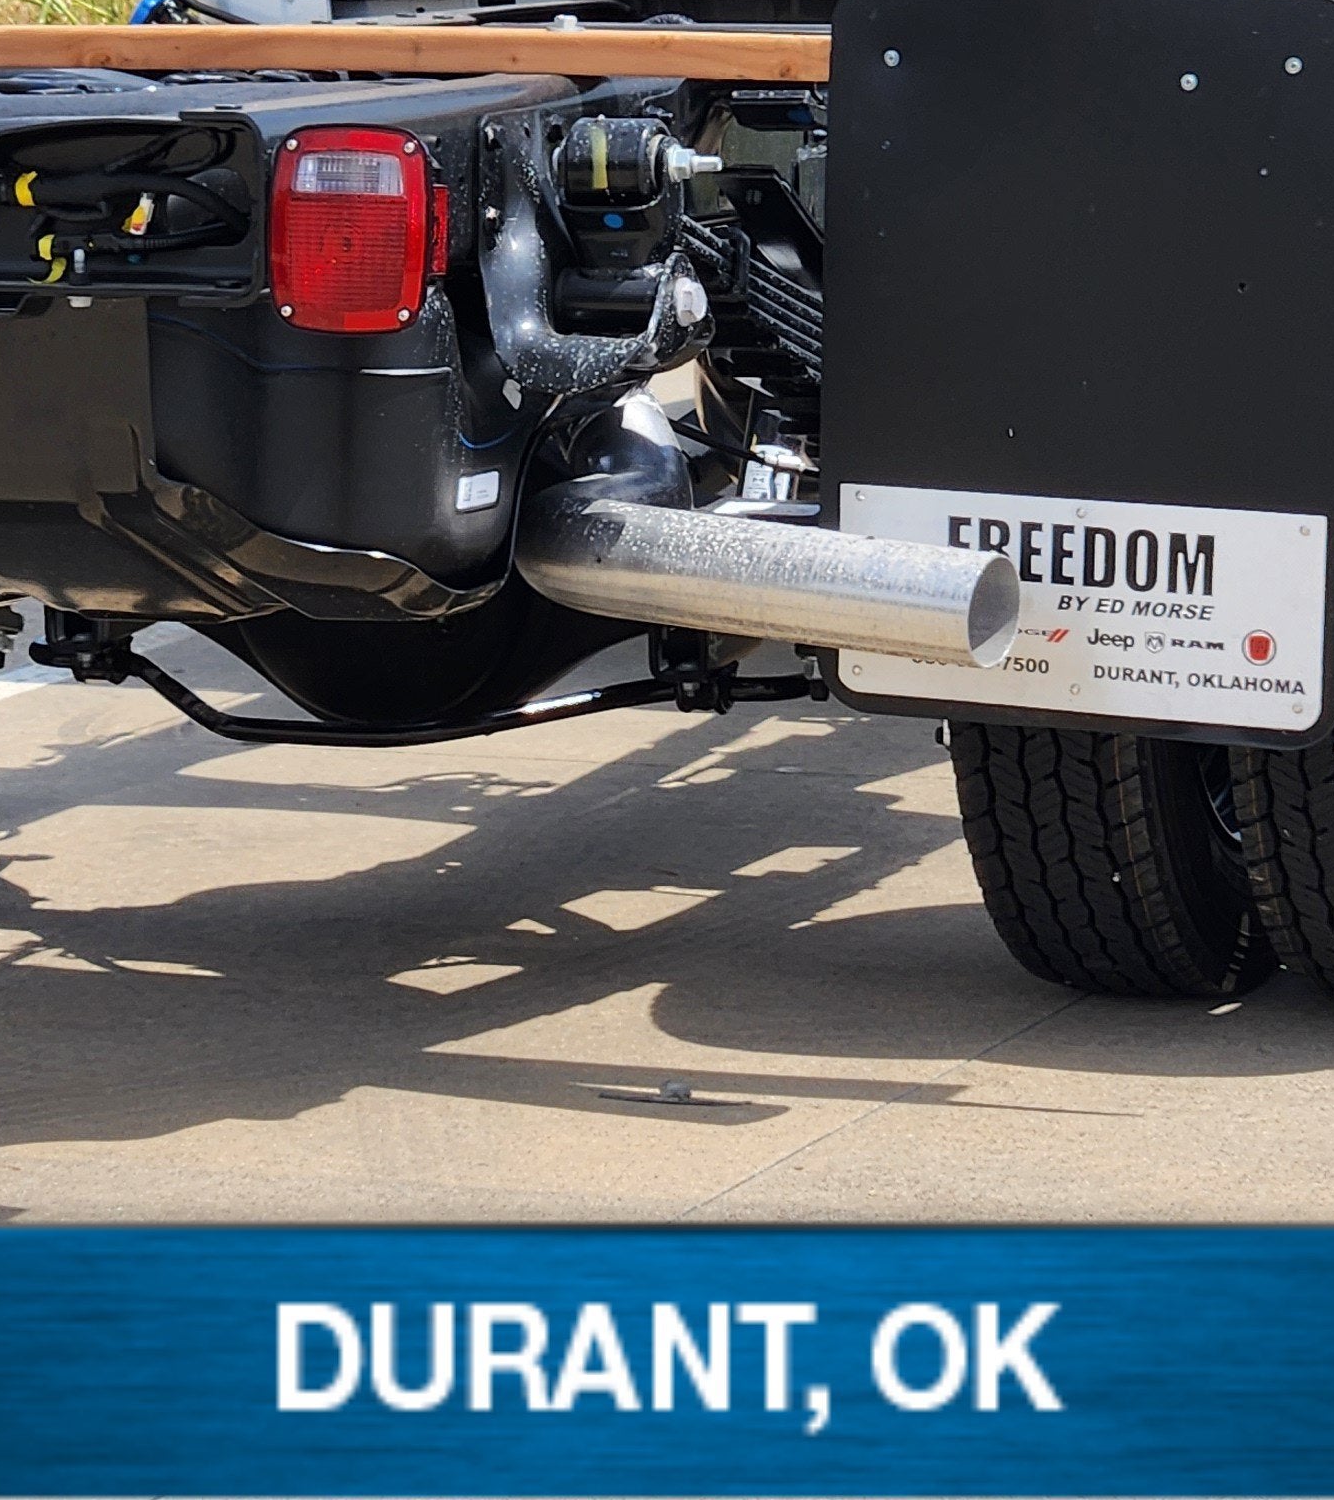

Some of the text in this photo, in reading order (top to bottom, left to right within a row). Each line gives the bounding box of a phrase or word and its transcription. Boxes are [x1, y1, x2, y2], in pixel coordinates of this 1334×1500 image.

[1057, 595, 1215, 622] BY ED MORSE
[1087, 628, 1225, 650] Jeep RAM
[1093, 665, 1307, 696] DURANT, OKLAHOMA
